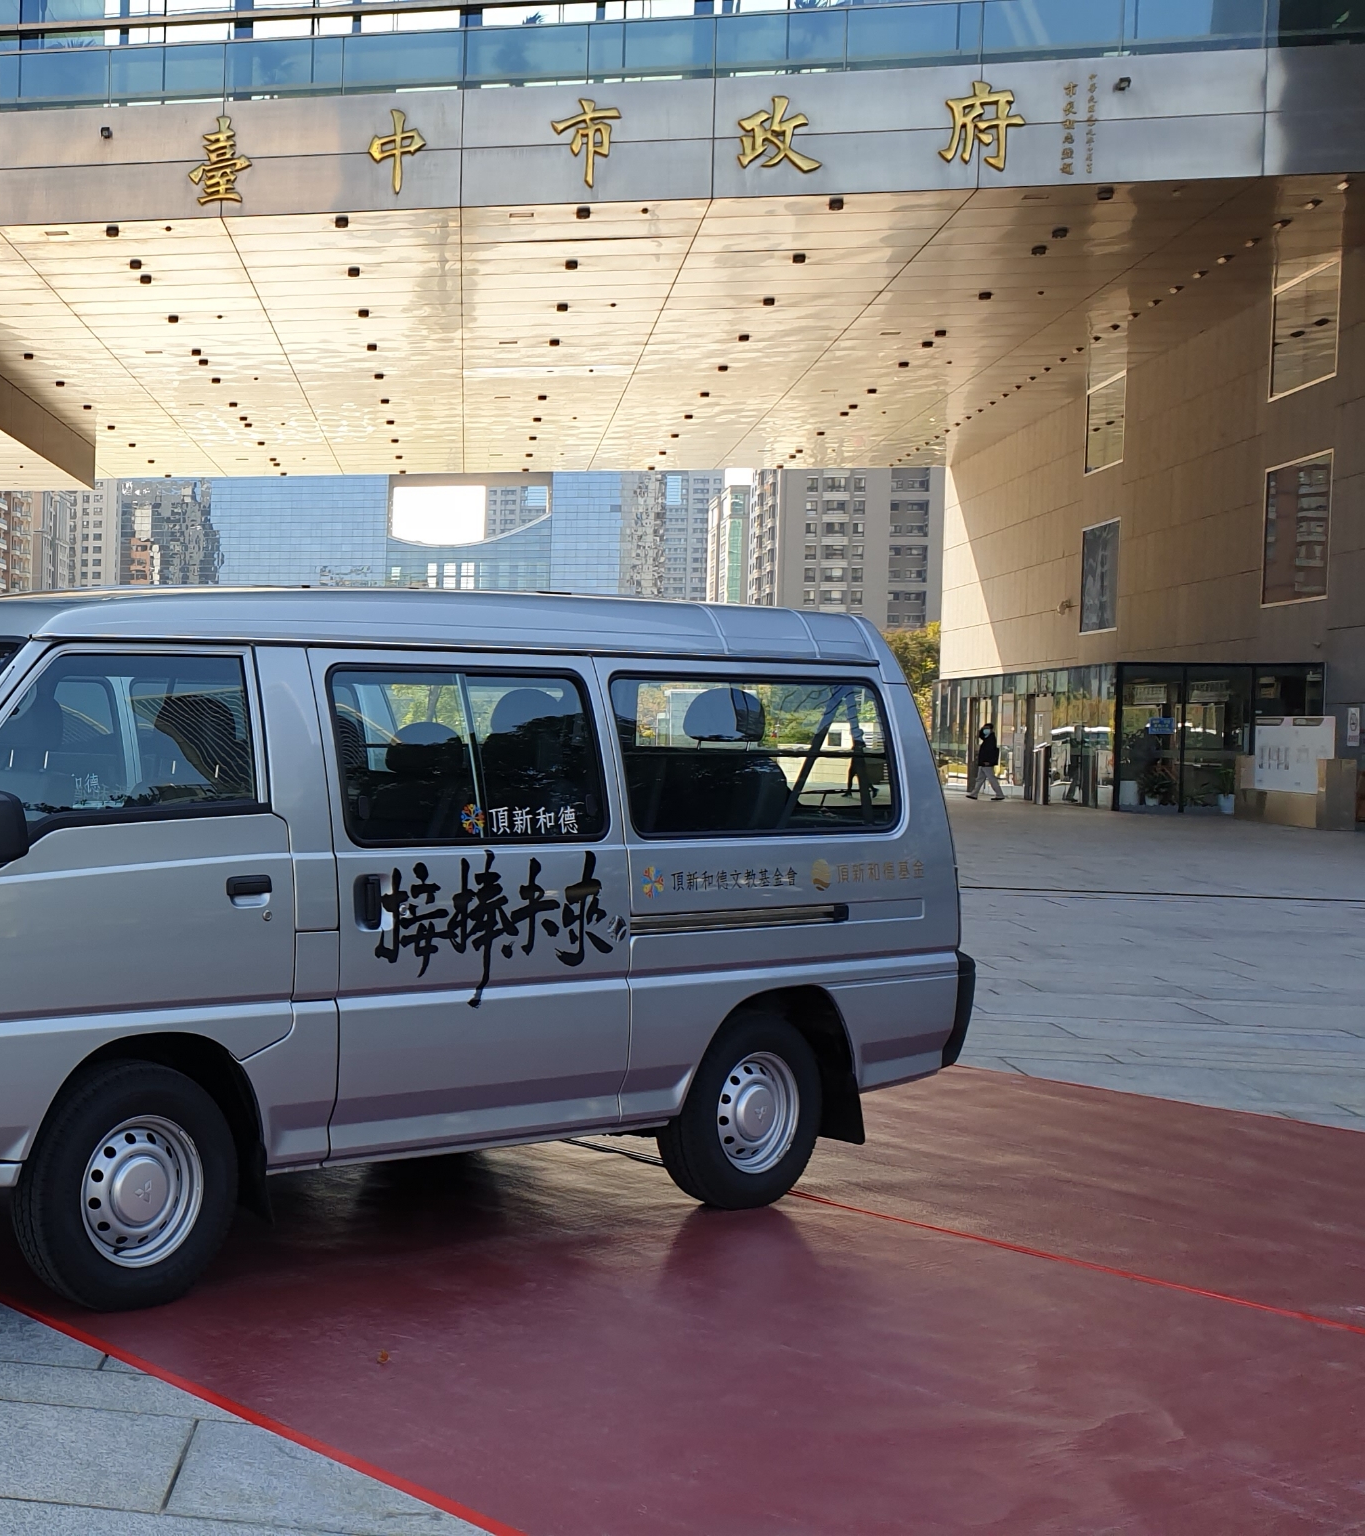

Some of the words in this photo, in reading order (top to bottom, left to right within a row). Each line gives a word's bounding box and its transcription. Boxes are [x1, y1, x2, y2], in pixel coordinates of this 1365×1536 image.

[187, 79, 1027, 206] 臺中市政府
[488, 805, 579, 835] 頂新和德
[671, 866, 798, 892] 頂新和德文教基金會
[837, 859, 926, 884] 頂新和德基金
